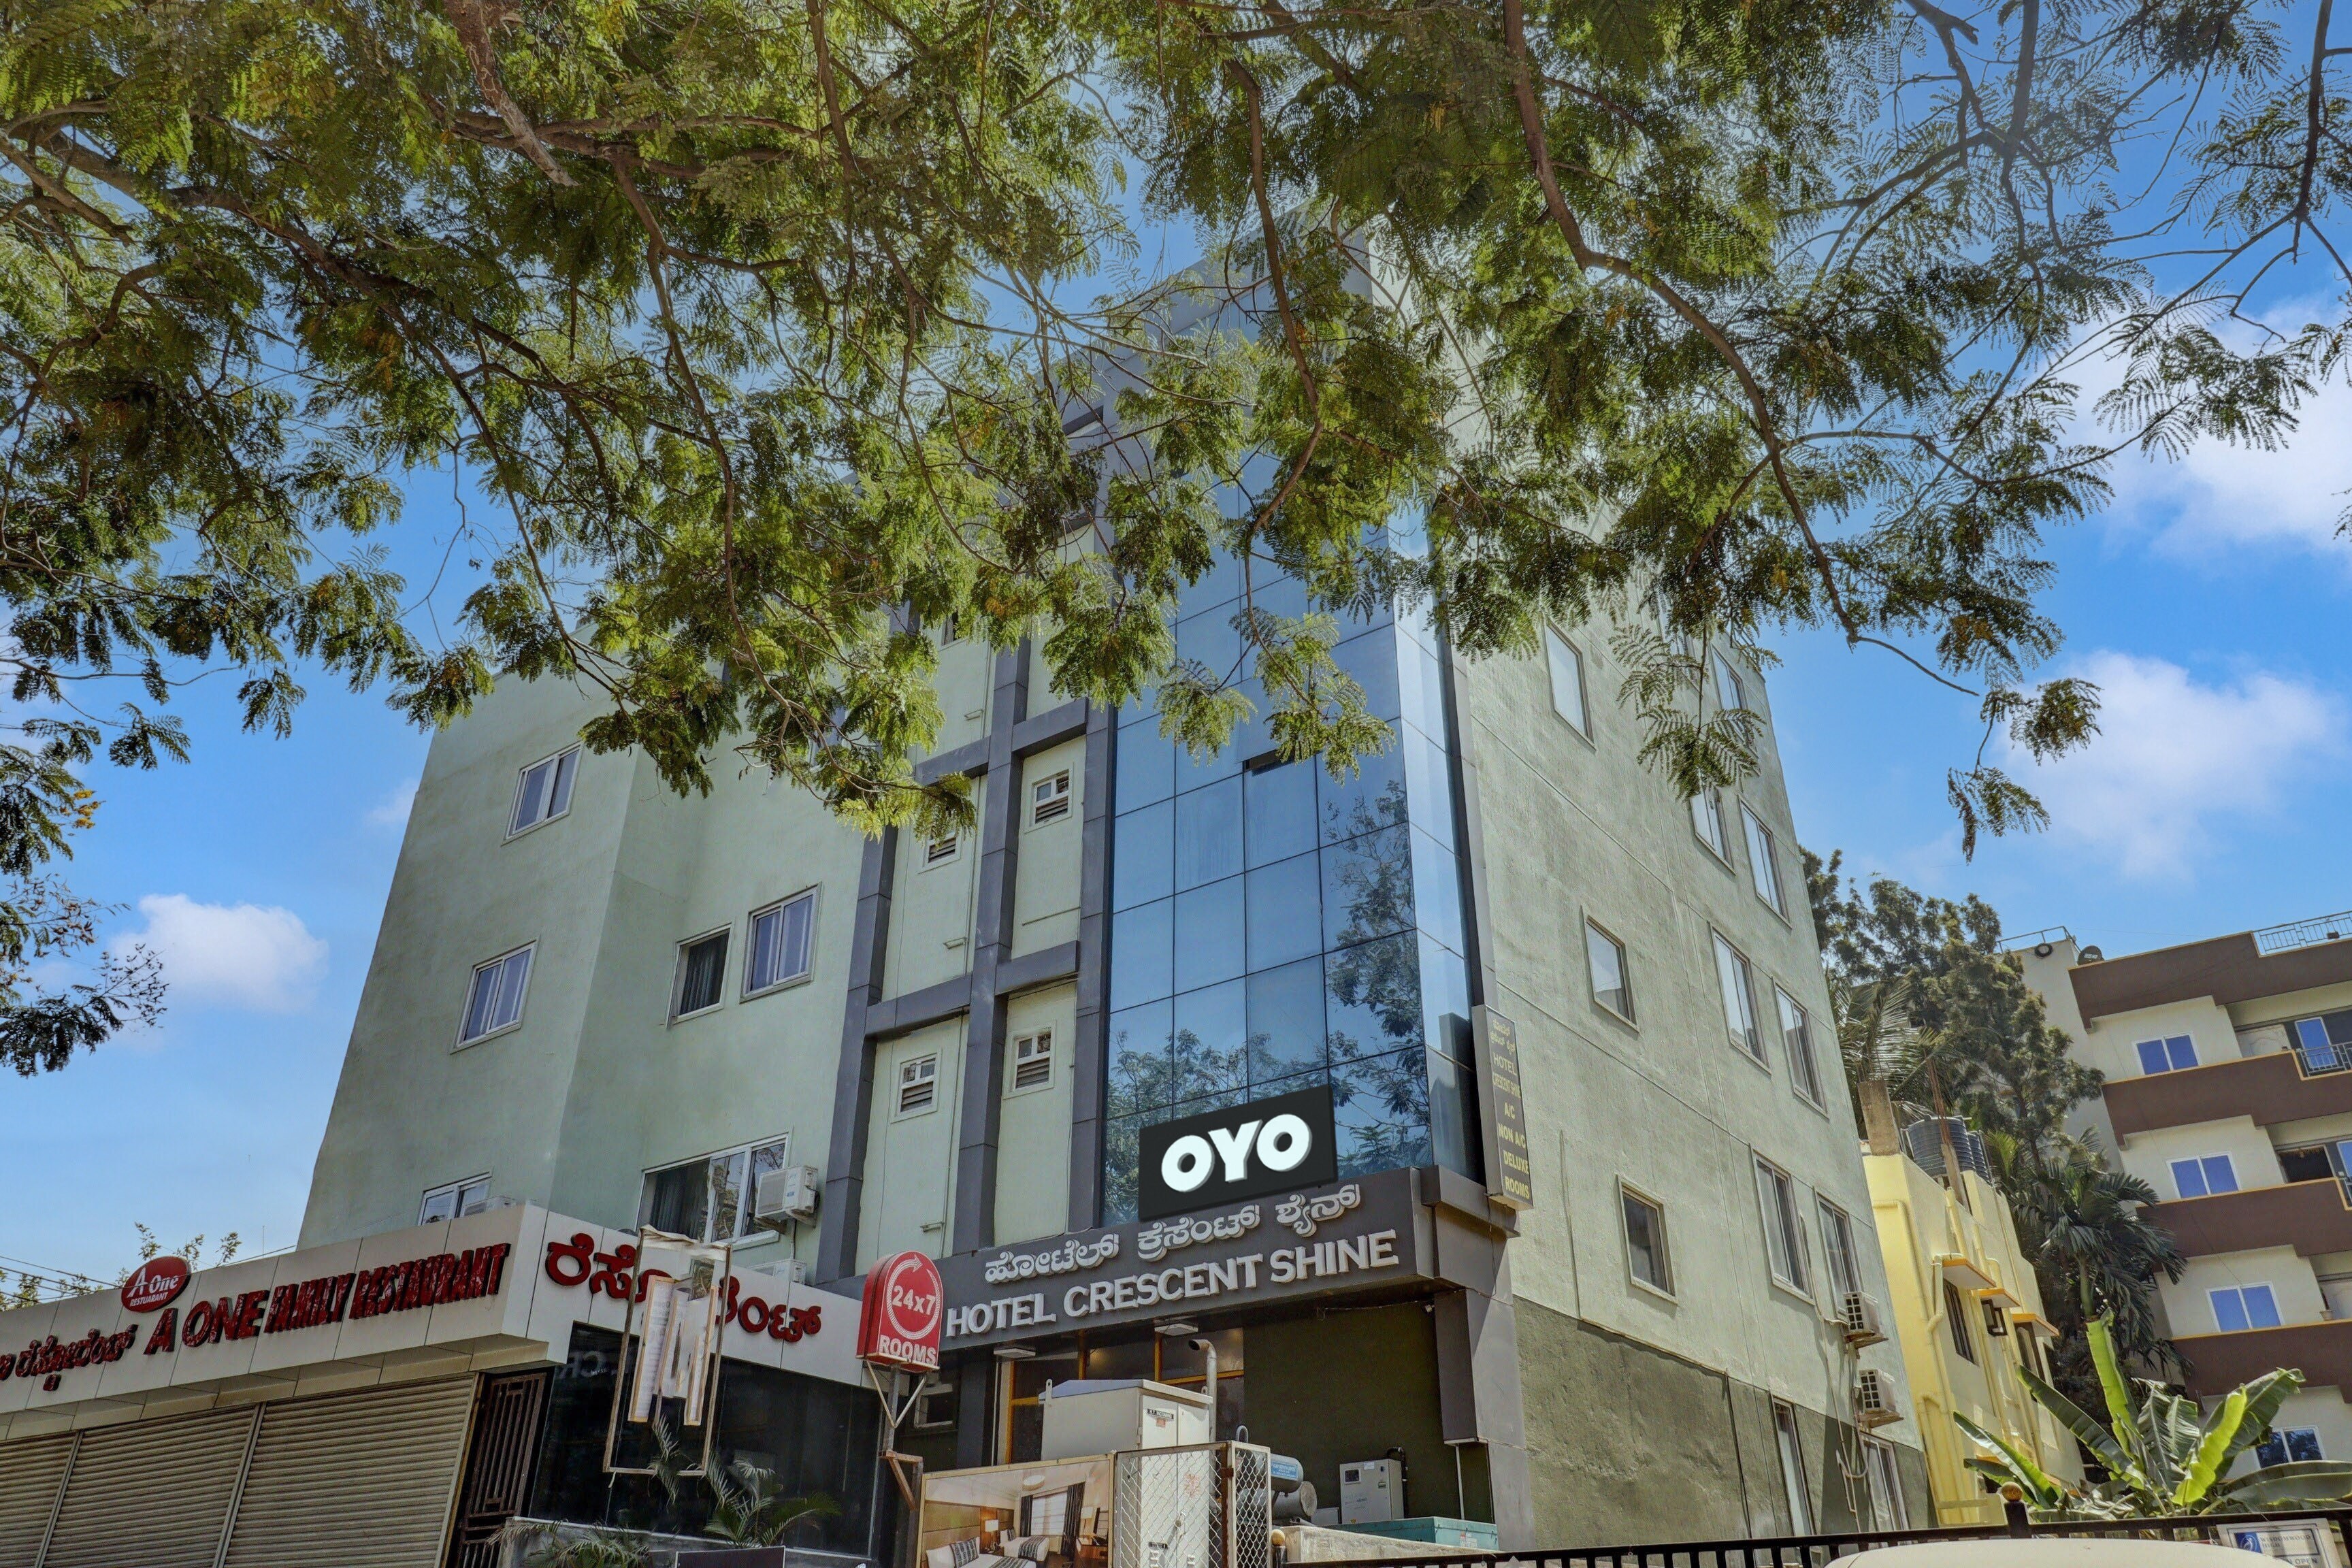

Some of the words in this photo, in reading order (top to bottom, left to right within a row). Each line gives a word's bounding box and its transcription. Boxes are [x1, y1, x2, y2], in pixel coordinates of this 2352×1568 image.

[1493, 1052, 1518, 1076] HOTEL
[1498, 1122, 1514, 1143] NON
[1161, 1113, 1312, 1192] OYO
[1503, 1149, 1529, 1175] DELUXE
[1505, 1175, 1530, 1200] ROOMS
[984, 1233, 1120, 1284] ಹೋಟೆಲ್
[1137, 1205, 1261, 1262] ಕ್ರೆಸೆಂಟ್
[1275, 1183, 1361, 1238] ಶೈನ್
[127, 1267, 148, 1298] A
[149, 1275, 179, 1294] One
[945, 1292, 1057, 1337] HOTEL
[1063, 1253, 1263, 1318] CRESCENT
[1270, 1228, 1399, 1284] SHINE
[143, 1307, 178, 1356] A
[182, 1290, 270, 1348] ONE
[263, 1273, 357, 1334] FAMILY
[348, 1243, 511, 1320] RESTAURANT
[892, 1285, 936, 1316] 24x7
[879, 1335, 936, 1366] ROOMS
